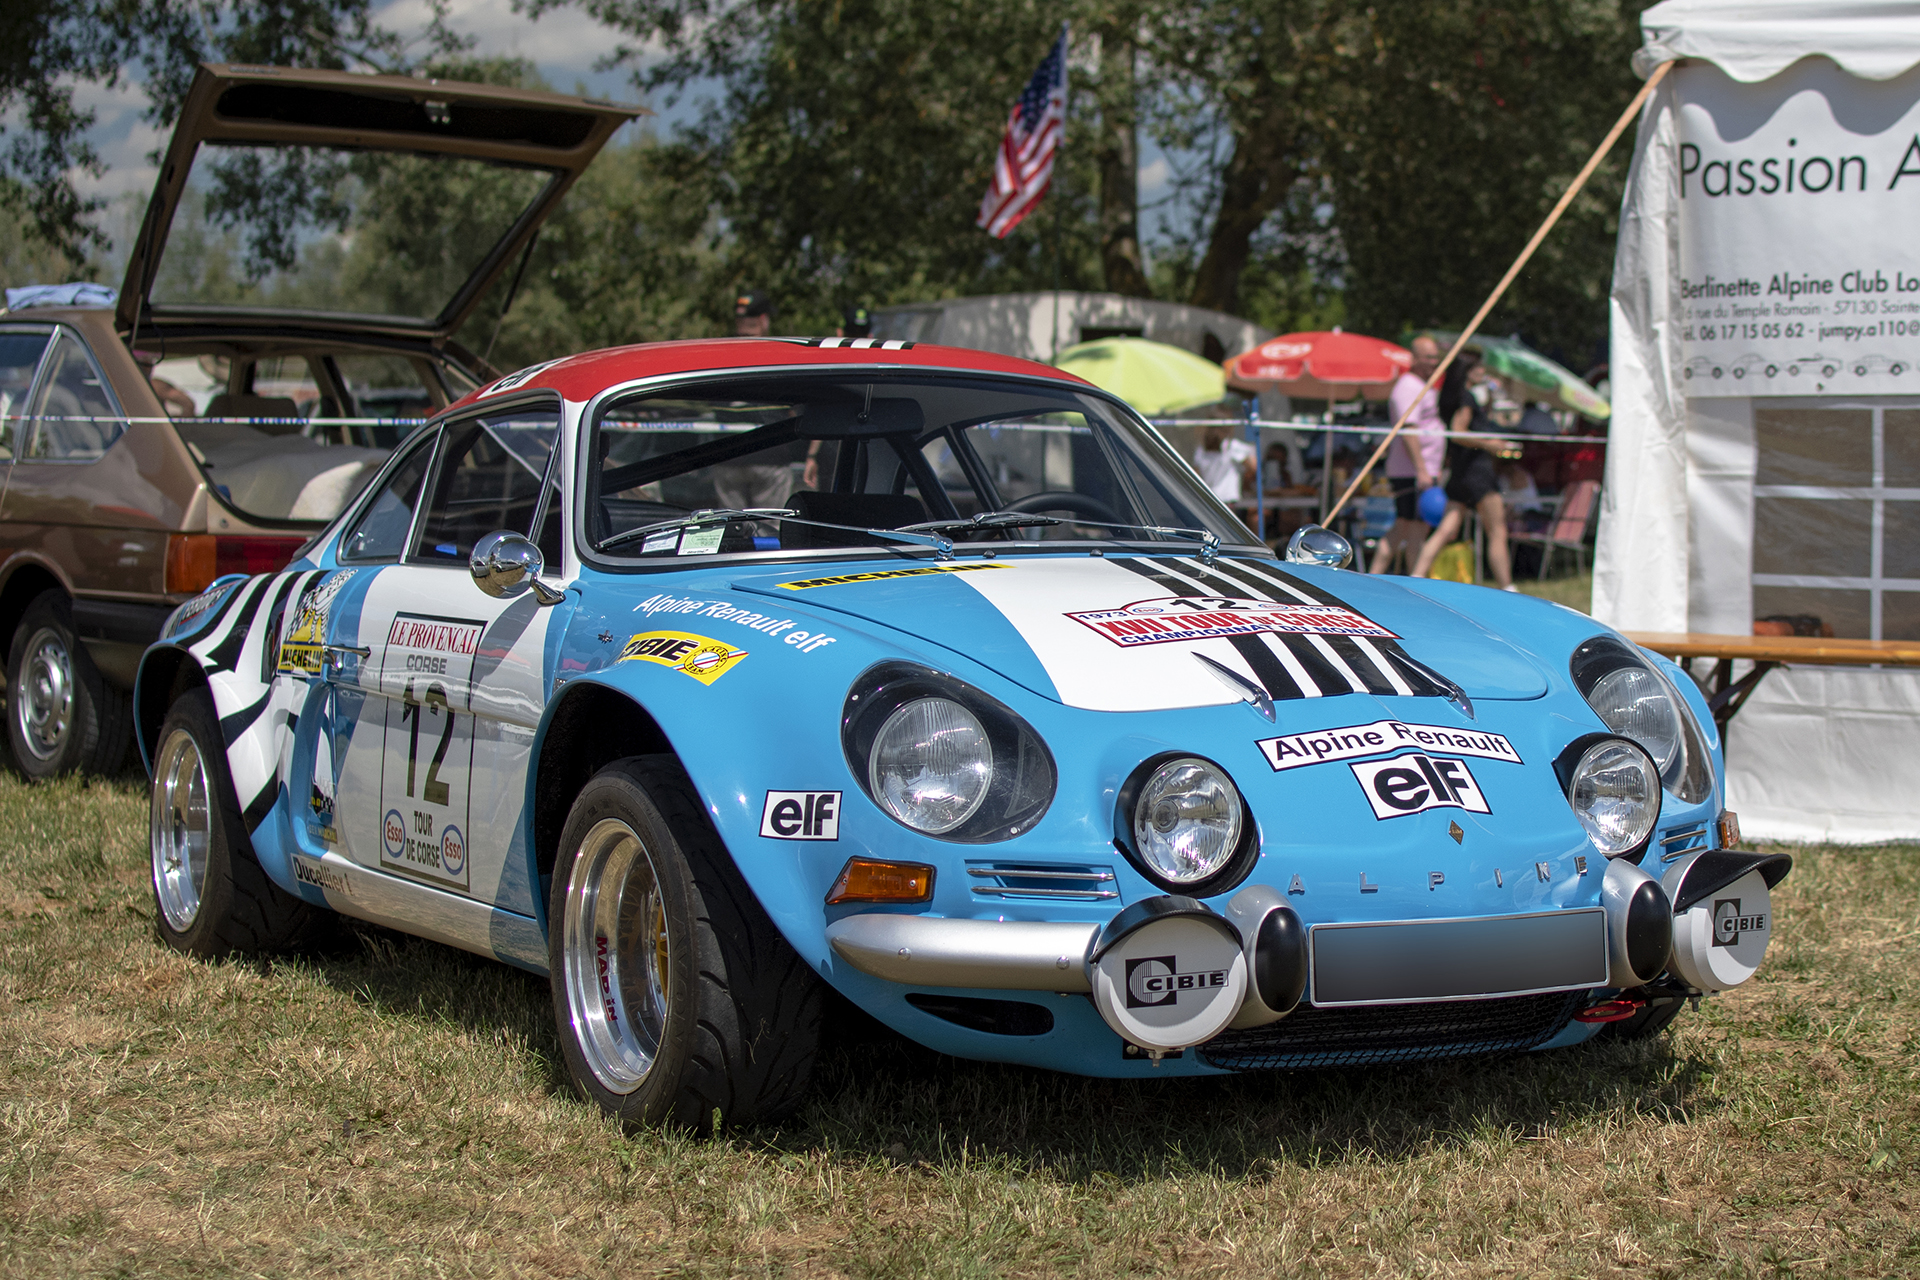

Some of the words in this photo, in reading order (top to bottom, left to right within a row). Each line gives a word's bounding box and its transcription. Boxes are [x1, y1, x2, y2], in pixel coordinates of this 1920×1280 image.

[1681, 138, 1866, 198] Passion
[1681, 274, 1760, 299] Berlinette
[1767, 271, 1833, 301] Alpine
[1840, 269, 1889, 293] Club
[1695, 308, 1711, 319] rue
[1714, 303, 1729, 318] du
[1731, 302, 1770, 320] Temple
[1774, 301, 1820, 317] Romain
[1833, 299, 1877, 315] 57130
[1699, 325, 1716, 340] 06
[1721, 324, 1737, 339] 17
[1742, 323, 1758, 339] 15
[1762, 323, 1780, 339] 05
[1784, 322, 1804, 338] 62
[789, 564, 1001, 588] MICHELIN
[1078, 611, 1128, 620] 1973
[1169, 599, 1252, 611] 12
[389, 620, 410, 646] LE
[633, 594, 701, 617] Alpine
[697, 601, 797, 637] Renault
[784, 630, 836, 653] elf
[1095, 618, 1172, 636] XVII
[1159, 612, 1253, 630] TOUR
[1249, 616, 1283, 625] DE
[1270, 612, 1375, 630] CORSE
[1121, 624, 1275, 643] CHAMPIONNAT
[1313, 626, 1389, 636] MONDE
[281, 649, 321, 668] MICHELIN
[407, 654, 447, 675] CORSE
[402, 677, 455, 806] 12
[1276, 728, 1385, 759] Alpine
[1388, 723, 1511, 755] Renault
[1374, 756, 1470, 810] elf
[413, 810, 433, 837] TOUR
[771, 794, 835, 836] elf
[386, 820, 403, 844] Esso
[406, 837, 415, 861] DE
[417, 841, 440, 869] CORSE
[444, 836, 462, 860] Esso
[1287, 855, 1590, 896] ALPINE
